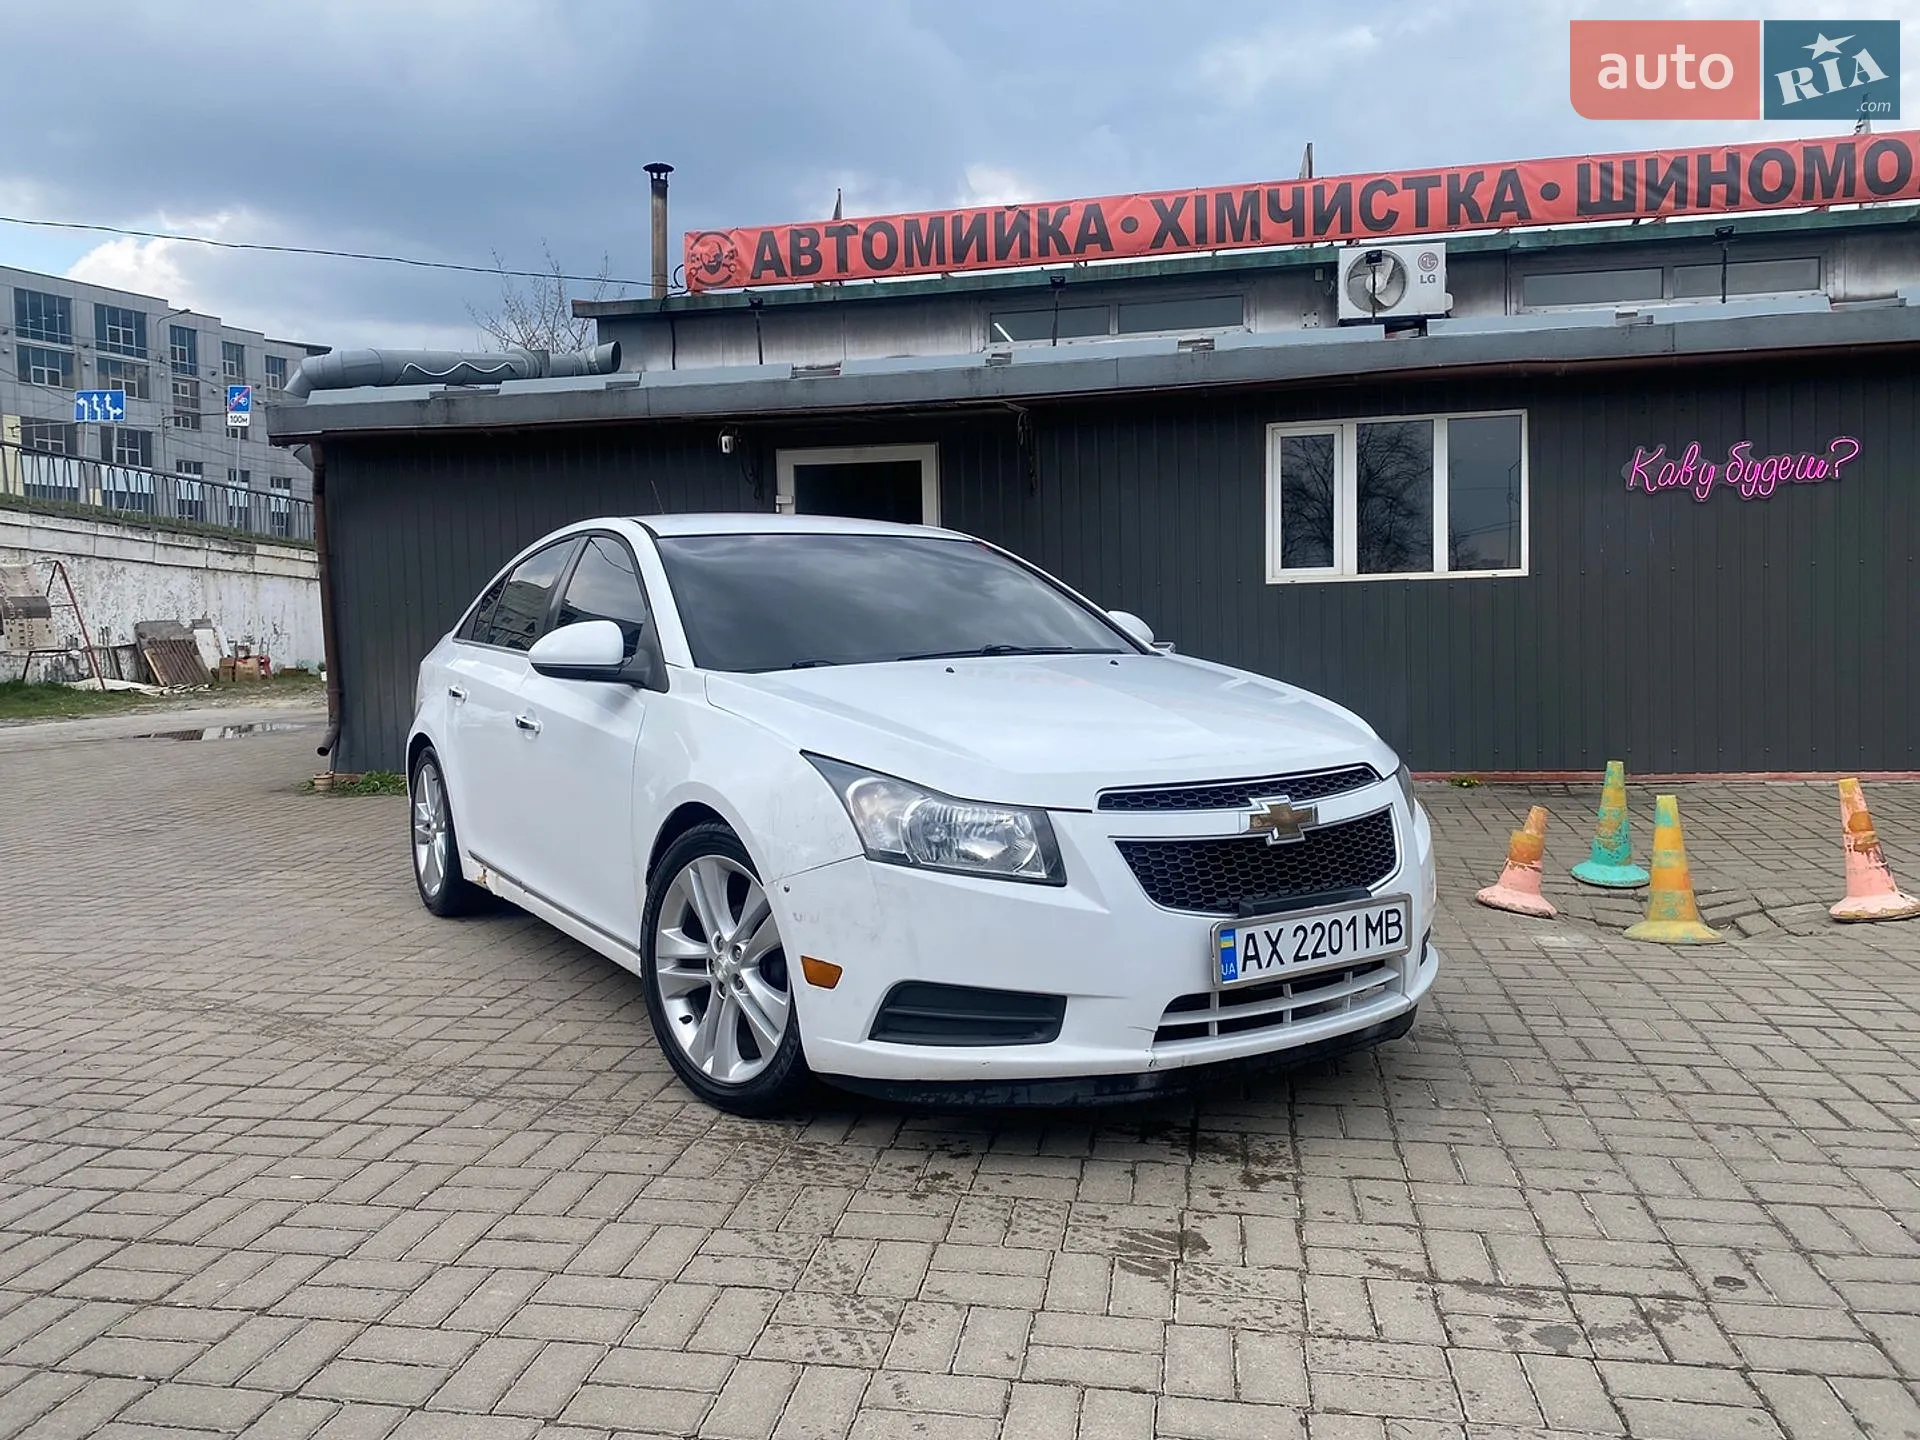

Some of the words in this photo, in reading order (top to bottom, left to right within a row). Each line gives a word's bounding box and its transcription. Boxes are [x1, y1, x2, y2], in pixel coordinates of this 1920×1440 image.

[751, 203, 1114, 280] АВТОМИЙКА
[1150, 168, 1532, 250] ХІМЧИСТКА
[1576, 138, 1920, 217] ШИНОМО
[1420, 274, 1436, 284] LG
[230, 415, 248, 424] 100м
[1629, 441, 1716, 501] Каву
[1725, 436, 1860, 498] будеш?
[1293, 915, 1358, 962] 2201
[1221, 961, 1236, 976] UA
